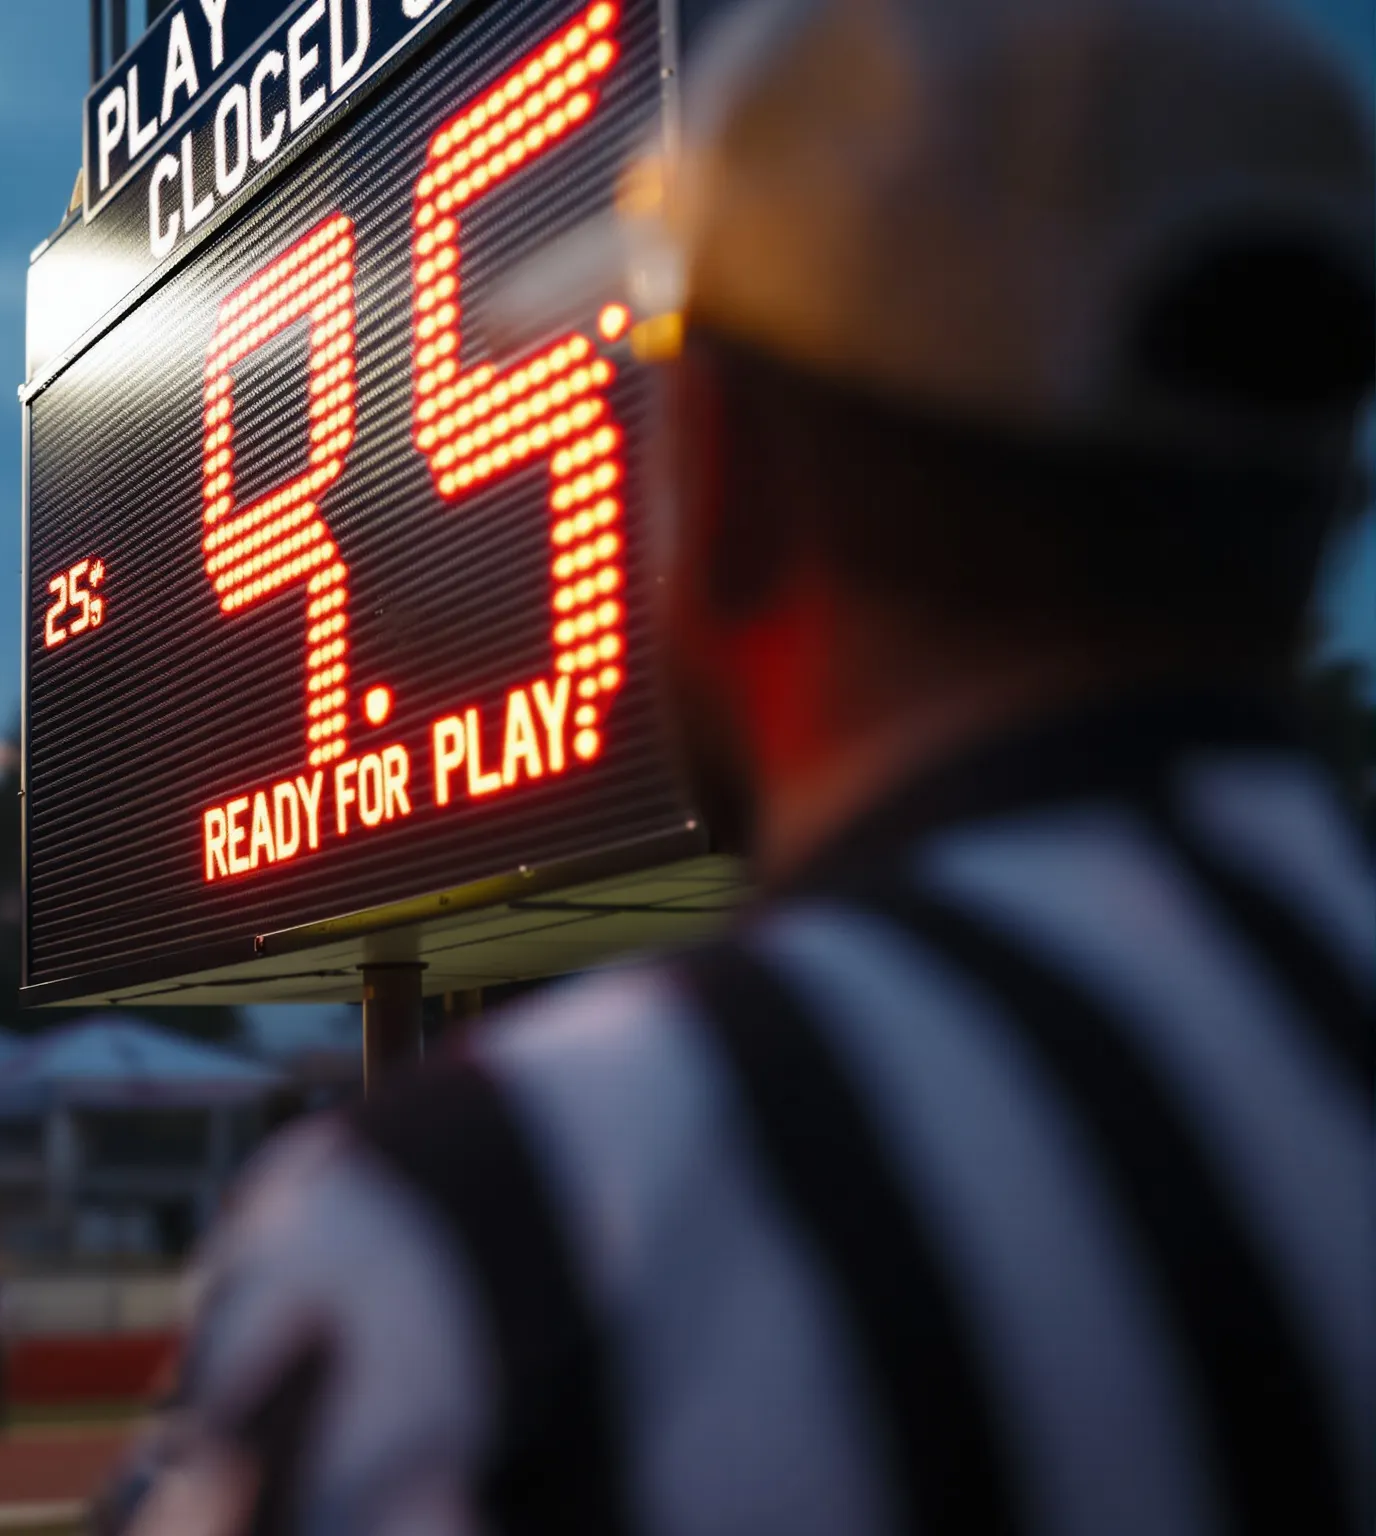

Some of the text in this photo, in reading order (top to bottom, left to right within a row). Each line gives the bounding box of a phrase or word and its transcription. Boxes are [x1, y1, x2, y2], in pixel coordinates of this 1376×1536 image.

[99, 0, 226, 191] PLAY
[149, 0, 371, 260] CLOCED
[203, 770, 325, 882] READY
[334, 743, 412, 835] FOR
